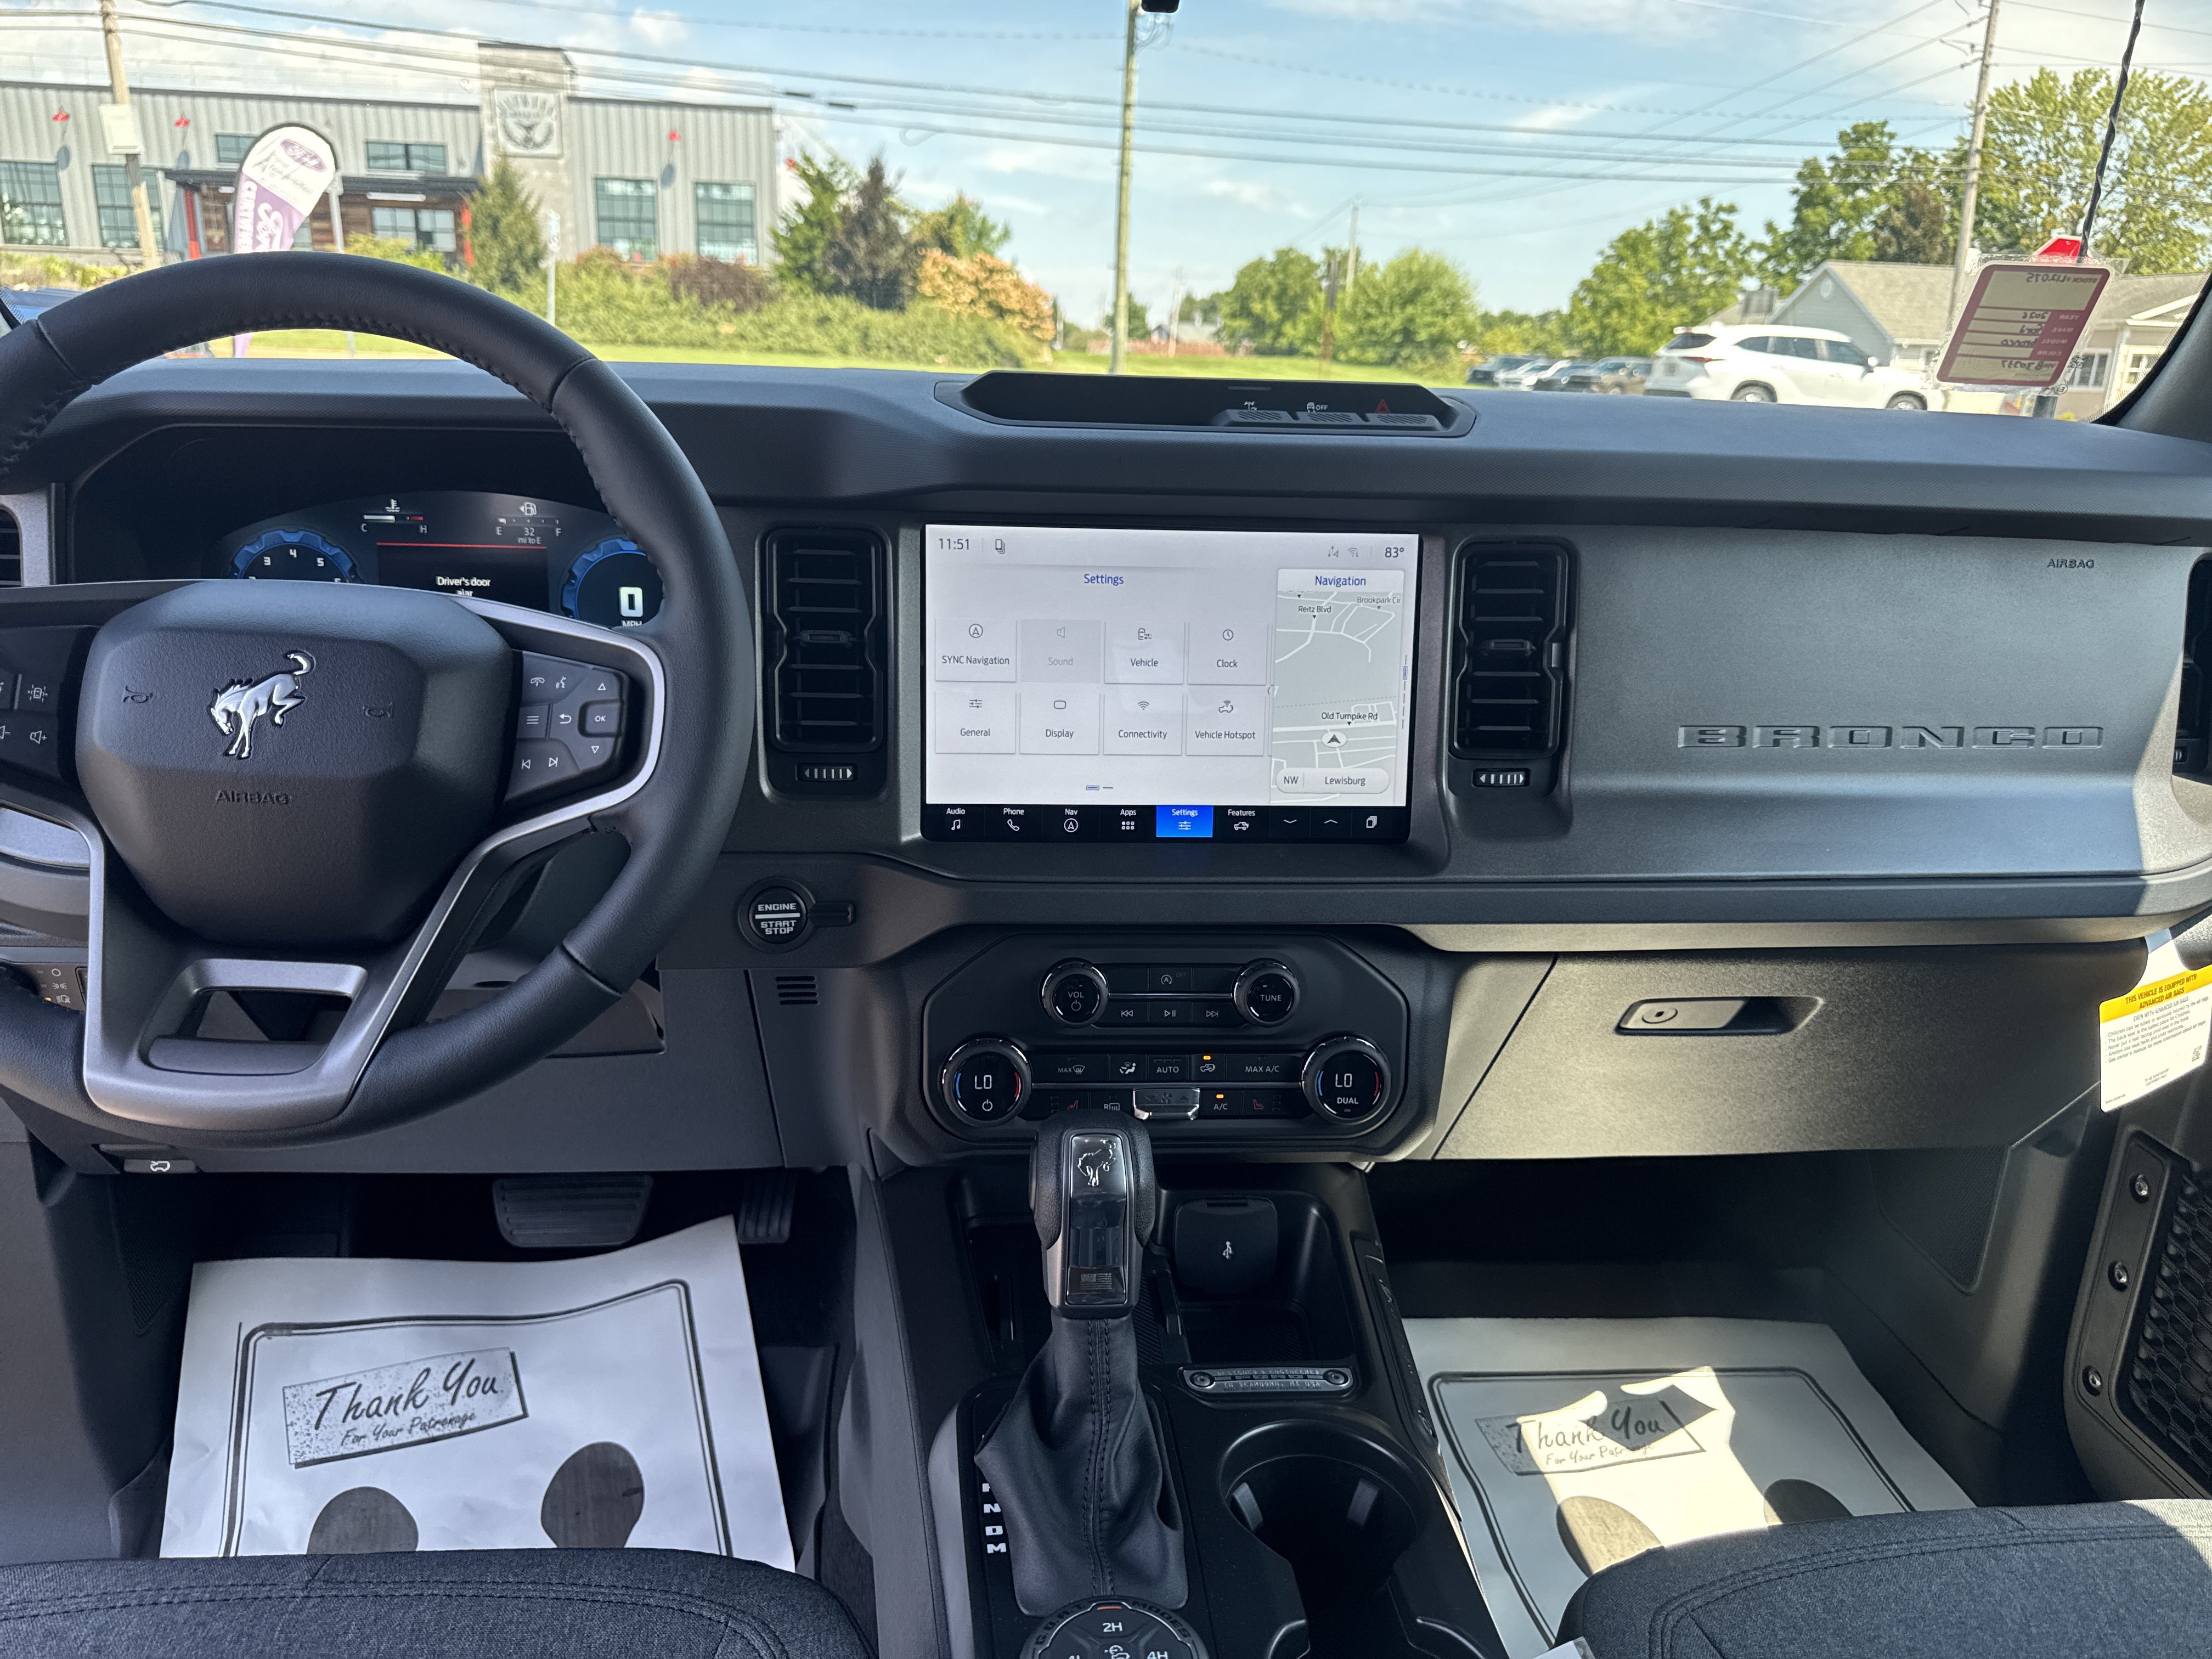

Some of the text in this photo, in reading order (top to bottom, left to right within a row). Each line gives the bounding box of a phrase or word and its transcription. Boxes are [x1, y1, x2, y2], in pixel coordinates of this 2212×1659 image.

[361, 523, 368, 533] C
[419, 525, 427, 534] H
[496, 527, 503, 535] E
[524, 527, 535, 537] 32
[556, 528, 562, 537] F
[939, 538, 970, 551] 11:51
[289, 548, 297, 558] 4
[1384, 547, 1404, 558] 83°
[263, 556, 271, 566] 3
[317, 557, 325, 567] 5
[2047, 558, 2095, 569] AIRBAG
[436, 576, 491, 586] Driver's door
[1084, 573, 1124, 586] Settings
[1314, 575, 1367, 588] Navigation
[618, 586, 644, 617] 0
[1357, 596, 1391, 605] Brookpark
[941, 655, 1009, 667] SYNC Navigation
[1047, 656, 1074, 666] Sound
[1130, 658, 1159, 668] Vehicle
[1216, 658, 1238, 668] Clock
[1336, 712, 1367, 721] Turnpike
[960, 727, 990, 737] General
[1045, 729, 1074, 740] Display
[1118, 729, 1167, 740] Connectivity
[1194, 730, 1256, 741] Vehicle Hotspot
[1678, 725, 2103, 749] BRONCO
[1283, 776, 1299, 785] NW
[1324, 776, 1365, 787] Lewisburg
[215, 789, 290, 805] AIRBAG
[946, 807, 966, 816] Audio
[1003, 807, 1025, 816] Phone
[1064, 808, 1078, 816] Nav
[1120, 808, 1137, 818] Apps
[1171, 808, 1198, 818] Settings
[1227, 808, 1256, 817] Features
[758, 903, 797, 911] ENGINE
[760, 919, 797, 928] START
[2125, 995, 2136, 1004] THIS
[2138, 988, 2158, 1000] VEHICLE
[2164, 979, 2185, 991] EQUIPPED
[2186, 974, 2197, 983] WITH
[2140, 997, 2164, 1009] ADVANCED
[2174, 988, 2184, 997] BAGS
[1245, 1064, 1280, 1074] MAX A/C
[974, 1075, 992, 1090] LO
[1335, 1073, 1353, 1088] LO
[1336, 1096, 1359, 1105] DUAL
[1103, 1103, 1109, 1111] R
[1213, 1102, 1228, 1111] A/C
[315, 1358, 498, 1430] Thank You
[341, 1412, 476, 1446] For Your Patronage
[1505, 1407, 1664, 1453] Thank You
[1545, 1452, 1595, 1465] For Your
[983, 1503, 1001, 1514] N
[985, 1525, 1003, 1536] D
[986, 1542, 1007, 1554] M
[1132, 1600, 1192, 1639] MODES
[1102, 1622, 1123, 1633] 2H
[1147, 1650, 1169, 1659] 4H
